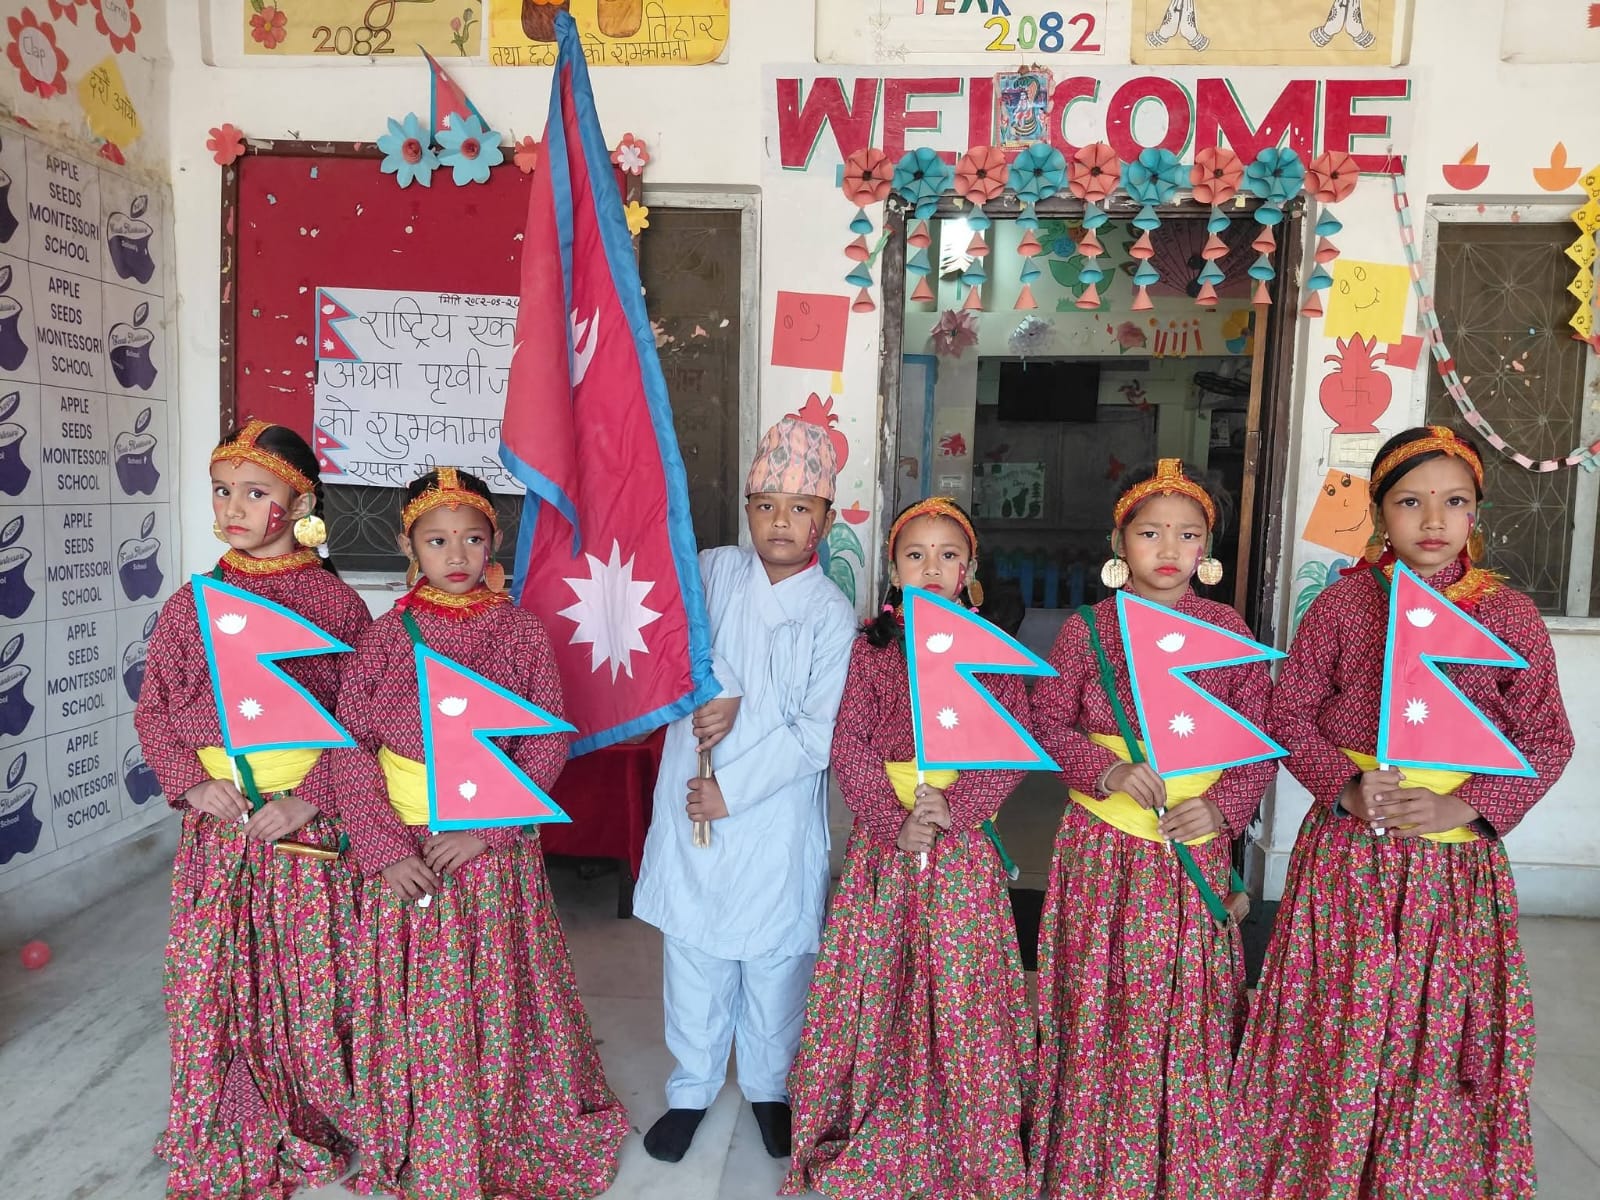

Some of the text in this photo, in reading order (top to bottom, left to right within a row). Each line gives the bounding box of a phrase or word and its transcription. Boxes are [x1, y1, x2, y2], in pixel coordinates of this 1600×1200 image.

[646, 2, 726, 41] तिहार
[984, 11, 1101, 53] 2082
[23, 36, 45, 67] Clap
[312, 26, 395, 56] 2082
[491, 46, 521, 66] तथा
[46, 155, 79, 182] APPLE
[49, 181, 82, 208] SEEDS
[29, 202, 99, 241] MONTESSORI
[45, 234, 90, 263] SCHOOL
[48, 276, 80, 299] APPLE
[50, 303, 82, 325] SEEDS
[37, 326, 102, 354] MONTESSORI
[51, 354, 94, 378] SCHOOL
[323, 360, 403, 389] अथवा
[60, 396, 89, 415] APPLE
[61, 422, 93, 440] SEEDS
[319, 394, 504, 460] को शुभकामन
[42, 447, 109, 466] MONTESSORI
[57, 474, 100, 491] SCHOOL
[63, 512, 93, 529] APPLE
[64, 537, 94, 555] SEEDS
[48, 560, 112, 582] MONTESSORI
[62, 590, 103, 607] SCHOOL
[67, 621, 97, 642] APPLE
[68, 646, 99, 666] SEEDS
[47, 665, 116, 697] MONTESSORI
[61, 693, 105, 718] SCHOOL
[66, 731, 99, 755] APPLE
[67, 754, 100, 779] SEEDS
[53, 771, 117, 811] MONTESSORI
[67, 802, 111, 830] SCHOOL
